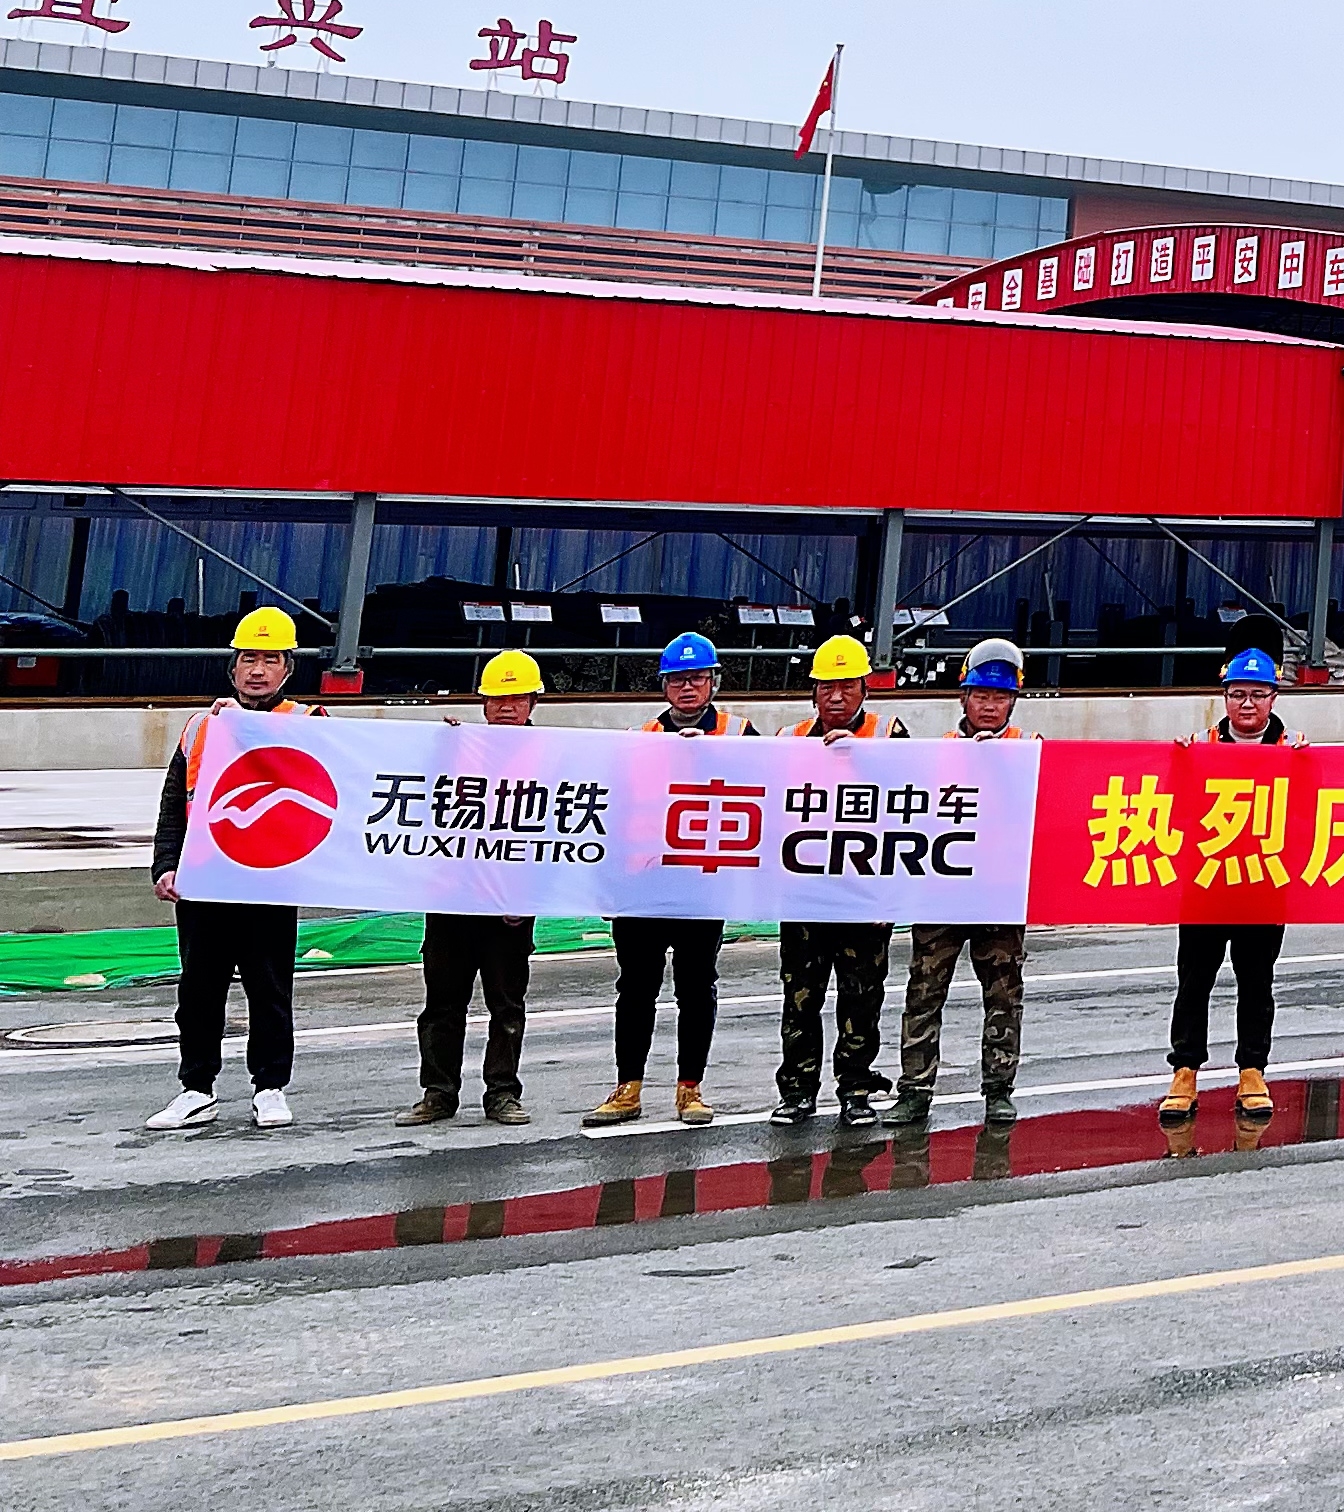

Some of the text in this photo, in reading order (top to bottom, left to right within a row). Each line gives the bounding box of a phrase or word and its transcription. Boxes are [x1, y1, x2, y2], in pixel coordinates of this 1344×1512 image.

[365, 773, 609, 836] 无锡地铁
[783, 782, 979, 825] 中国中车
[364, 832, 606, 865] WUXI METRO
[780, 829, 976, 877] CRRC
